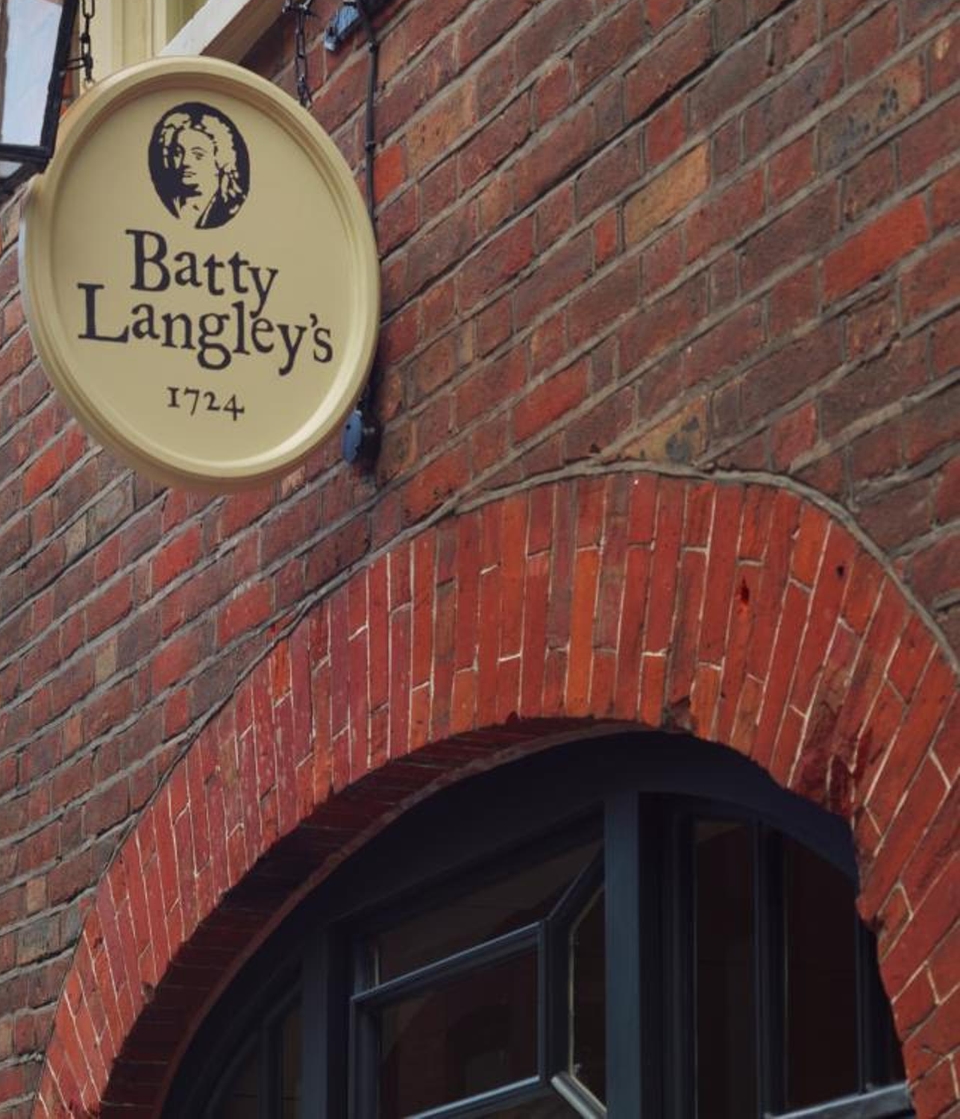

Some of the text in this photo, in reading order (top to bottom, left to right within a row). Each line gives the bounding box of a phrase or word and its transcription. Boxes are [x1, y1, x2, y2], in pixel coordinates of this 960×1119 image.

[124, 228, 279, 319] Batty
[76, 282, 334, 377] Langley's
[167, 386, 246, 422] 1724
